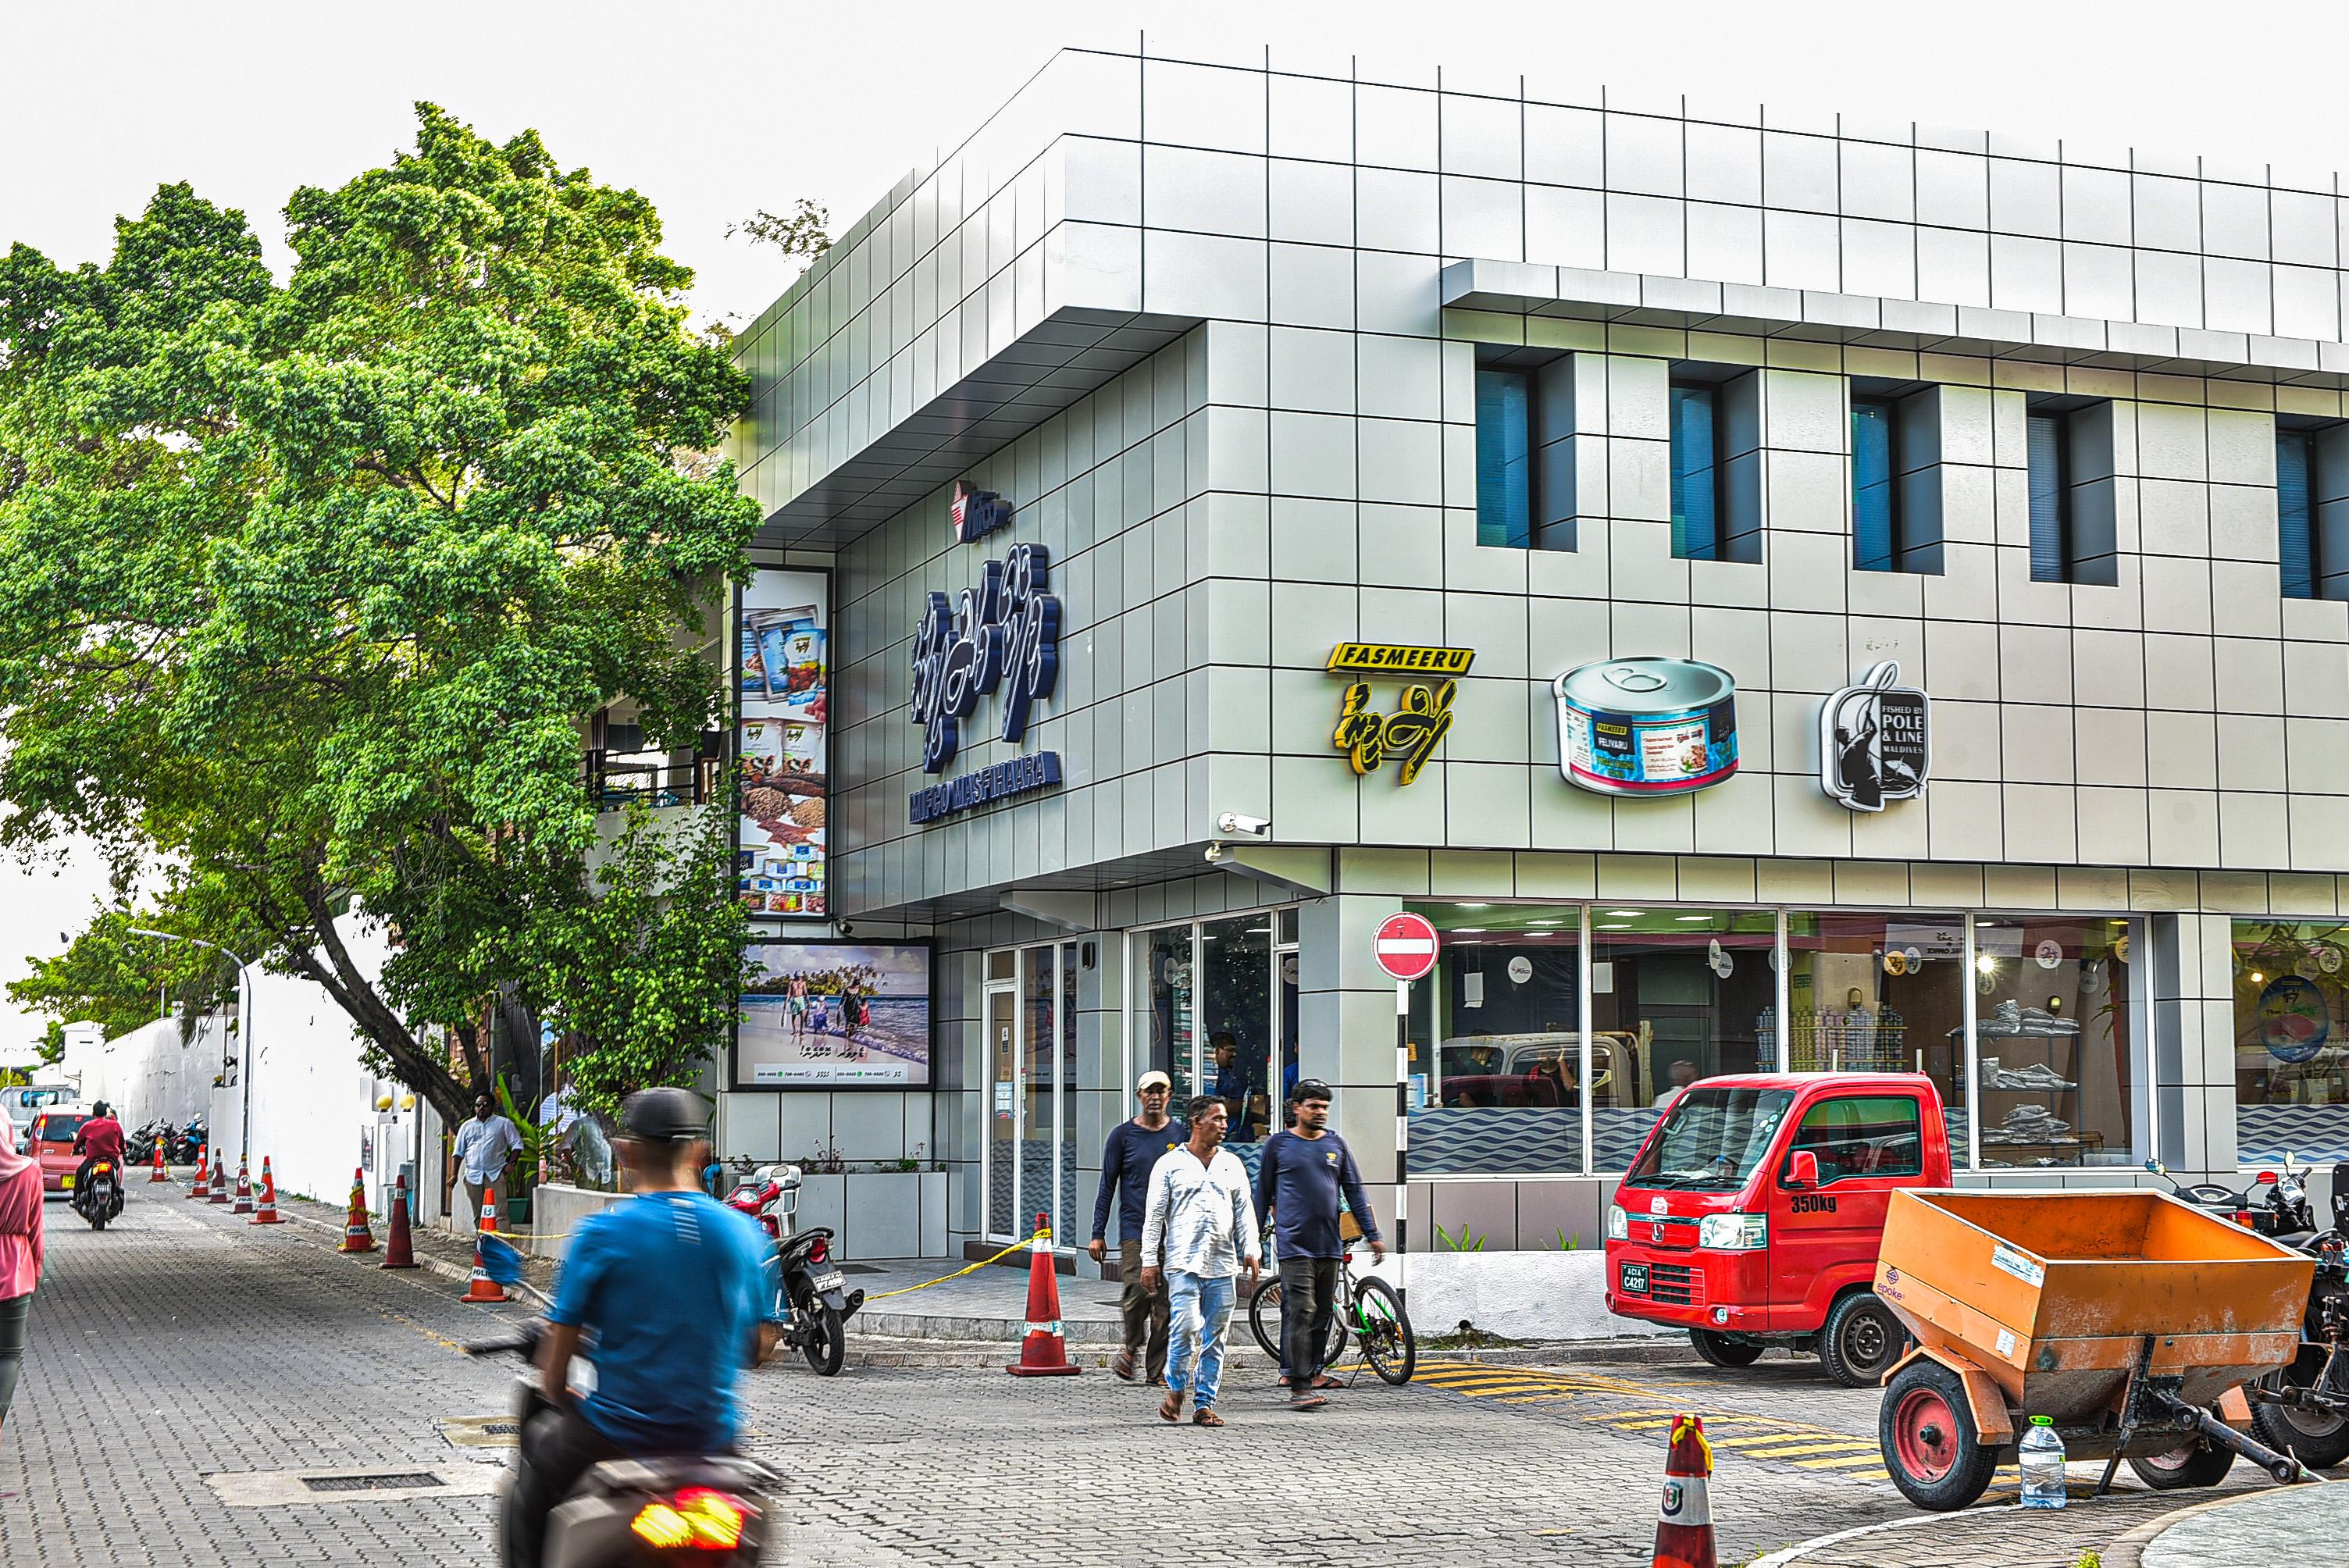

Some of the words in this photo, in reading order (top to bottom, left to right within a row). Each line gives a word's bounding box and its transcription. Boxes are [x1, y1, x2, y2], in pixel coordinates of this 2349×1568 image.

[1342, 647, 1465, 668] FASMEERU
[1882, 705, 1912, 714] FISHED
[1882, 714, 1923, 730] POLE
[1882, 730, 1891, 742] &
[1895, 731, 1923, 743] LINE
[1882, 745, 1923, 754] MALDIVES
[910, 781, 950, 825] MIFCO
[1791, 1195, 1837, 1213] 350kg
[1624, 1276, 1645, 1289] C4217
